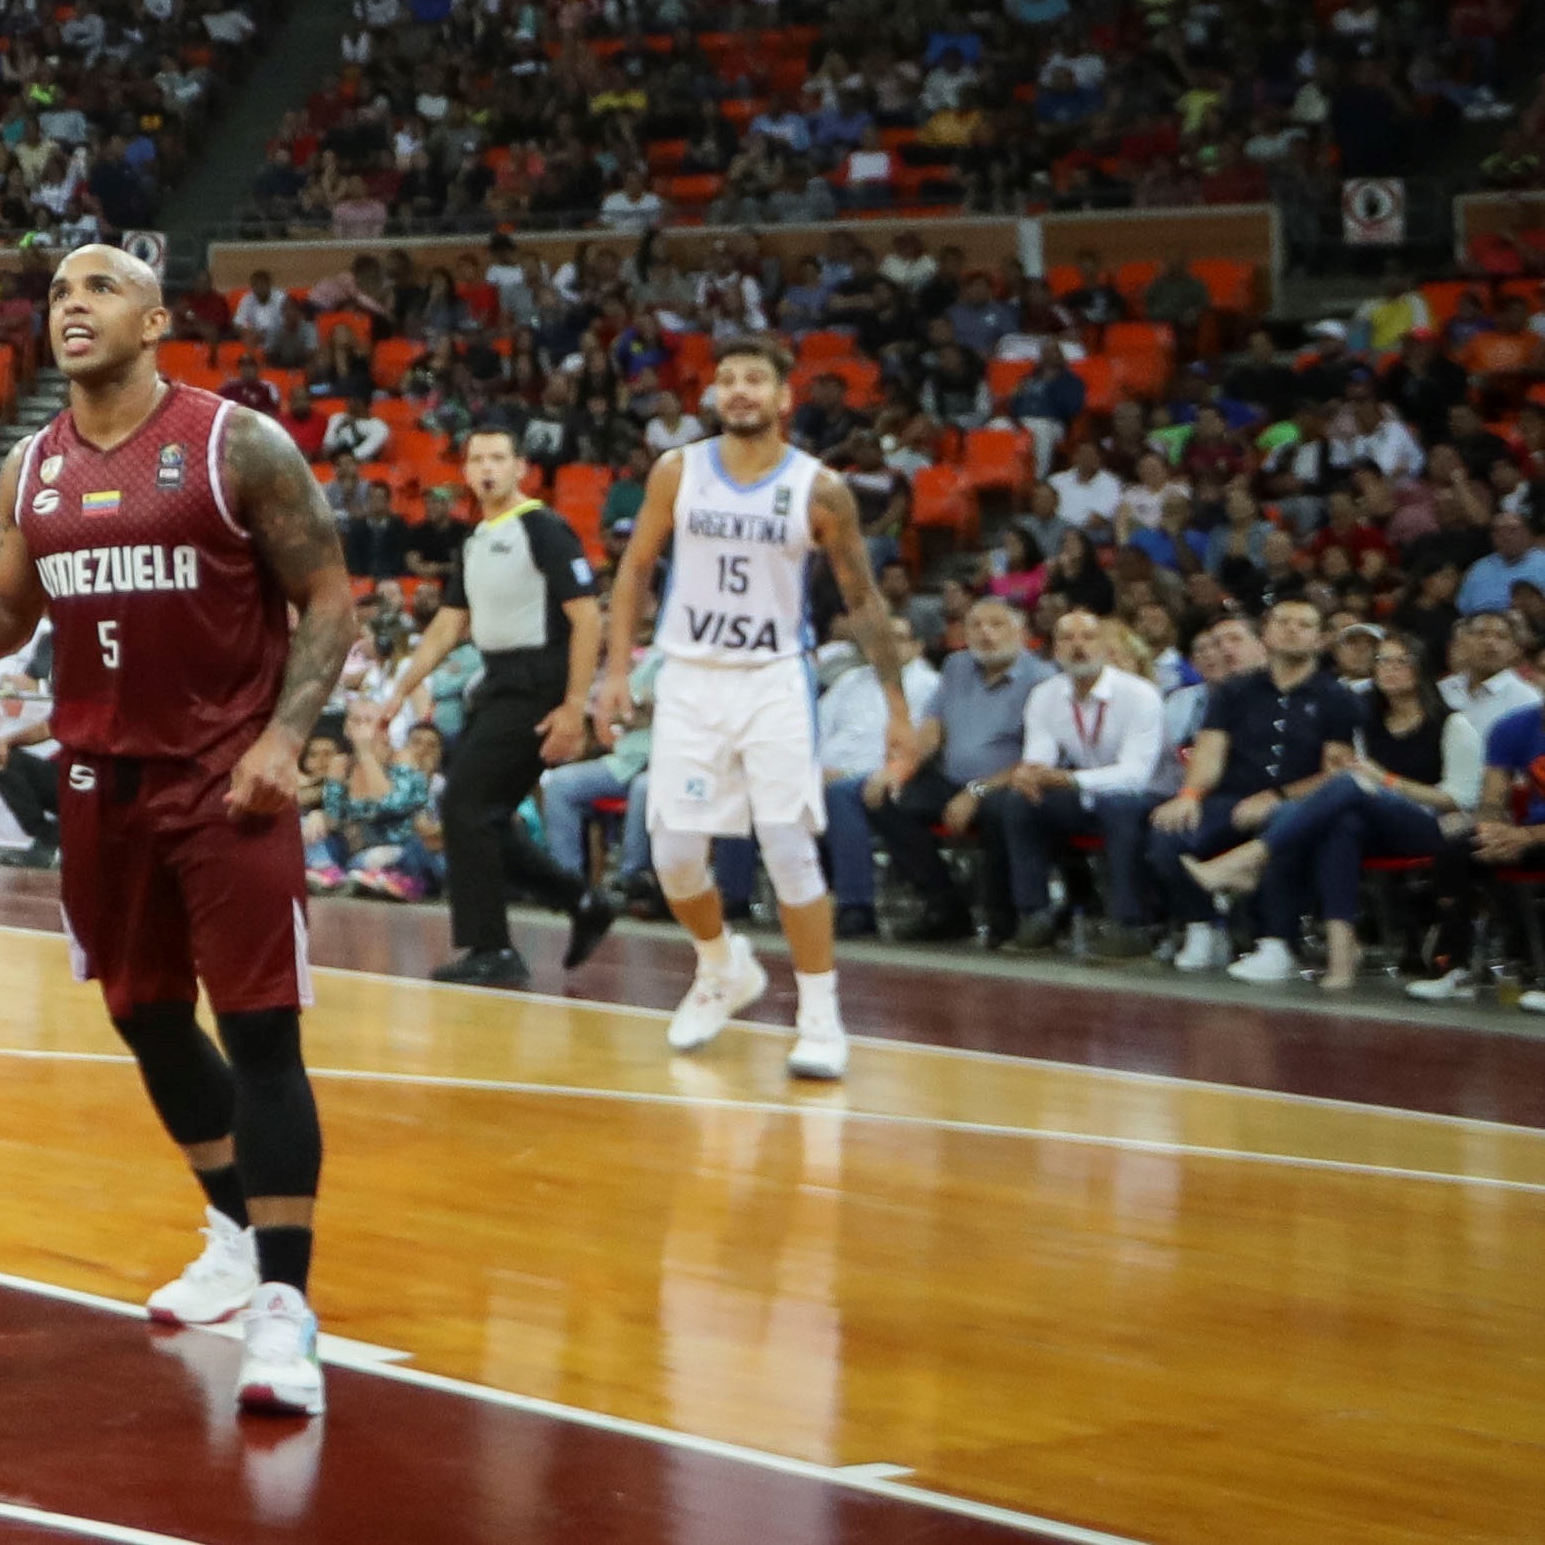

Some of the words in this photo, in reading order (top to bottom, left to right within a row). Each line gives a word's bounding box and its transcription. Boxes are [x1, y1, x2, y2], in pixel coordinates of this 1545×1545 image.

[686, 509, 787, 545] ARGENTINA
[716, 555, 750, 596] 15
[96, 620, 122, 670] 5
[683, 605, 780, 653] VISA
